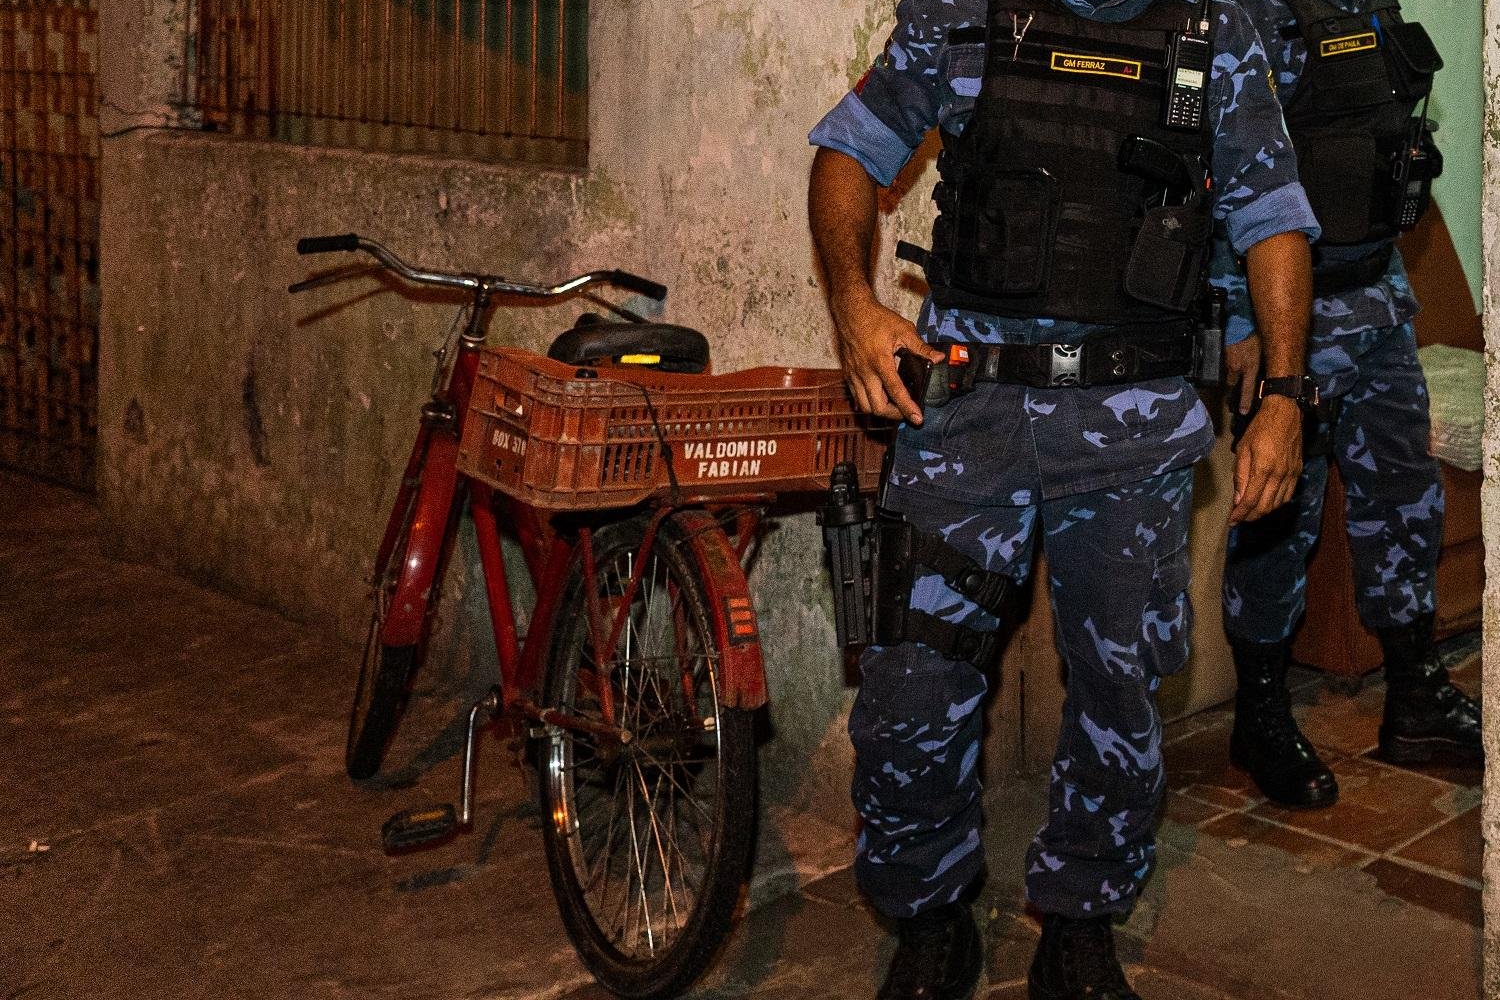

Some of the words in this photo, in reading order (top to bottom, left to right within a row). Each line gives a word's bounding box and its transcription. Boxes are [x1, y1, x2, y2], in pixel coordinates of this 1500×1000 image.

[1063, 59, 1076, 67] GM
[1077, 60, 1106, 70] FERRAZ
[492, 429, 510, 450] BOX
[684, 440, 777, 459] VALDOMIRO
[698, 460, 761, 478] FABIAN
